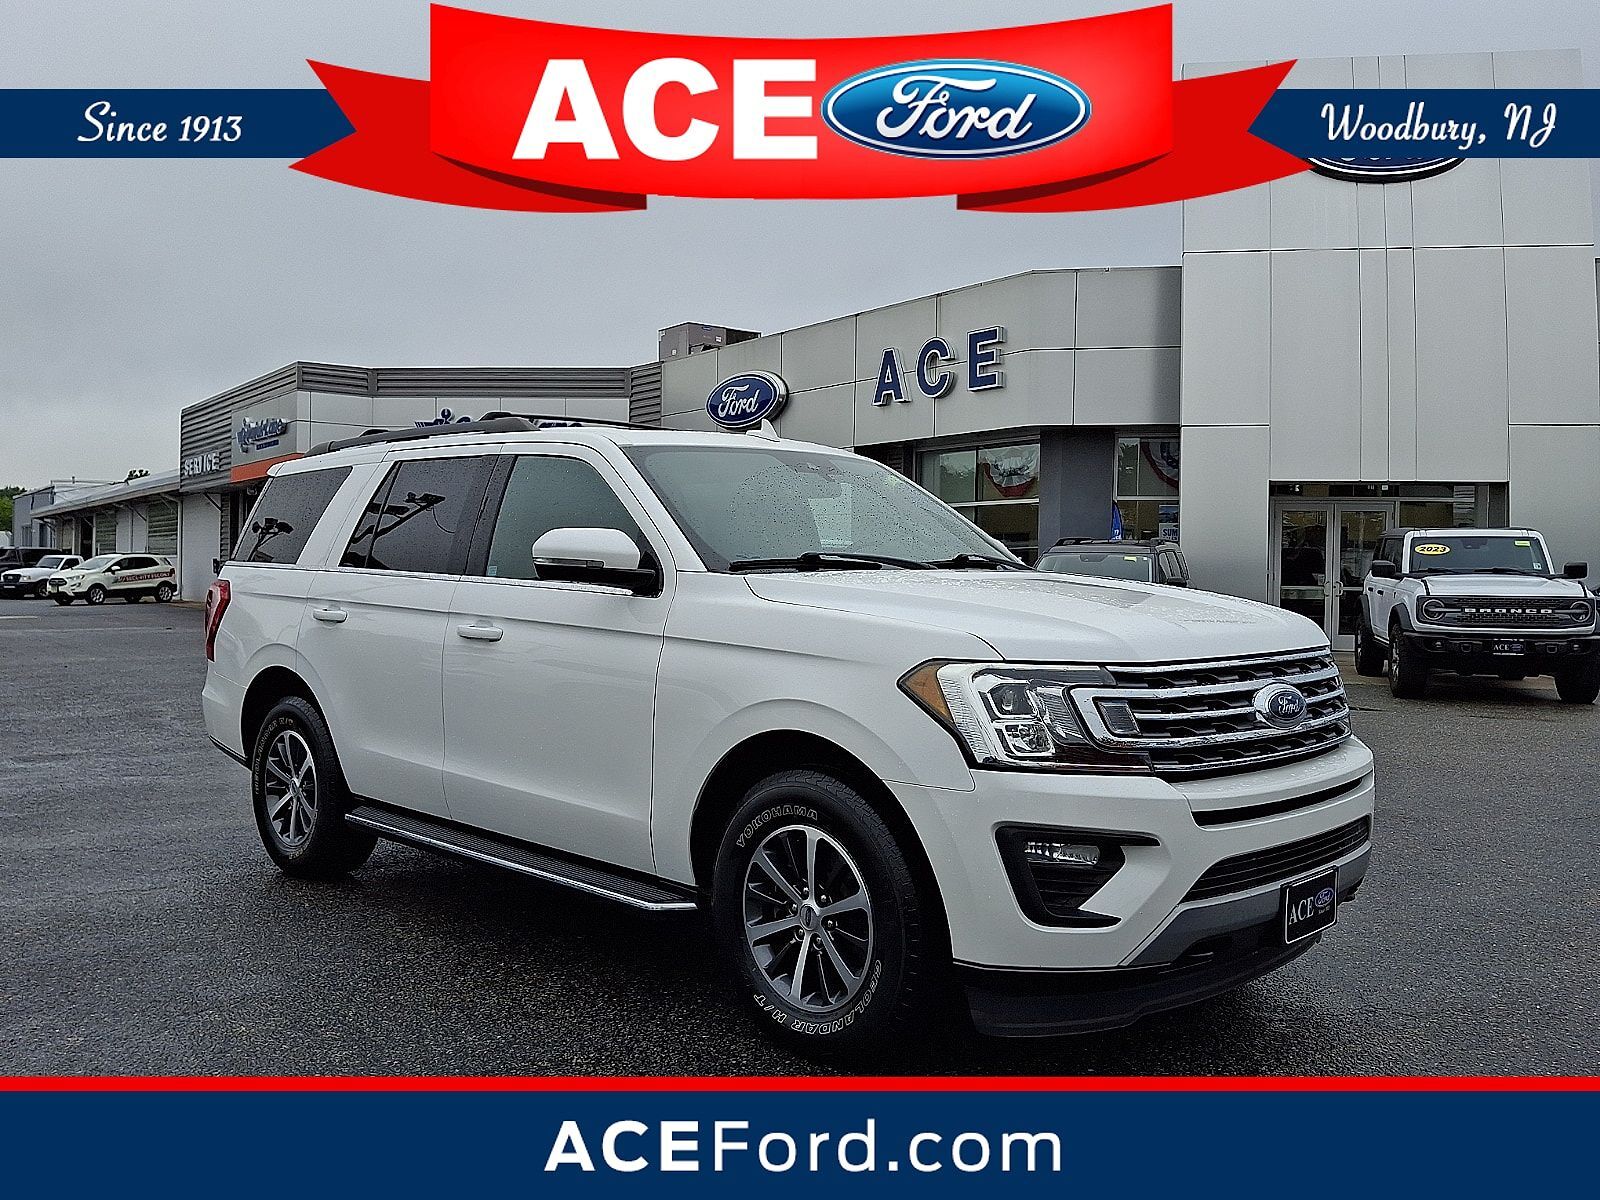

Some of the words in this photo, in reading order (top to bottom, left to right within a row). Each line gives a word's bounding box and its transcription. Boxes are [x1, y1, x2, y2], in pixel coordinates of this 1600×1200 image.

[872, 325, 1006, 407] ACE
[718, 384, 760, 418] Ford
[184, 452, 220, 476] SERVICE
[1278, 695, 1301, 714] Ford
[736, 805, 818, 848] YOKOHAMA
[1288, 896, 1314, 926] ACE
[754, 991, 788, 1024] H/T
[791, 959, 882, 1034] GEOLANDAR
